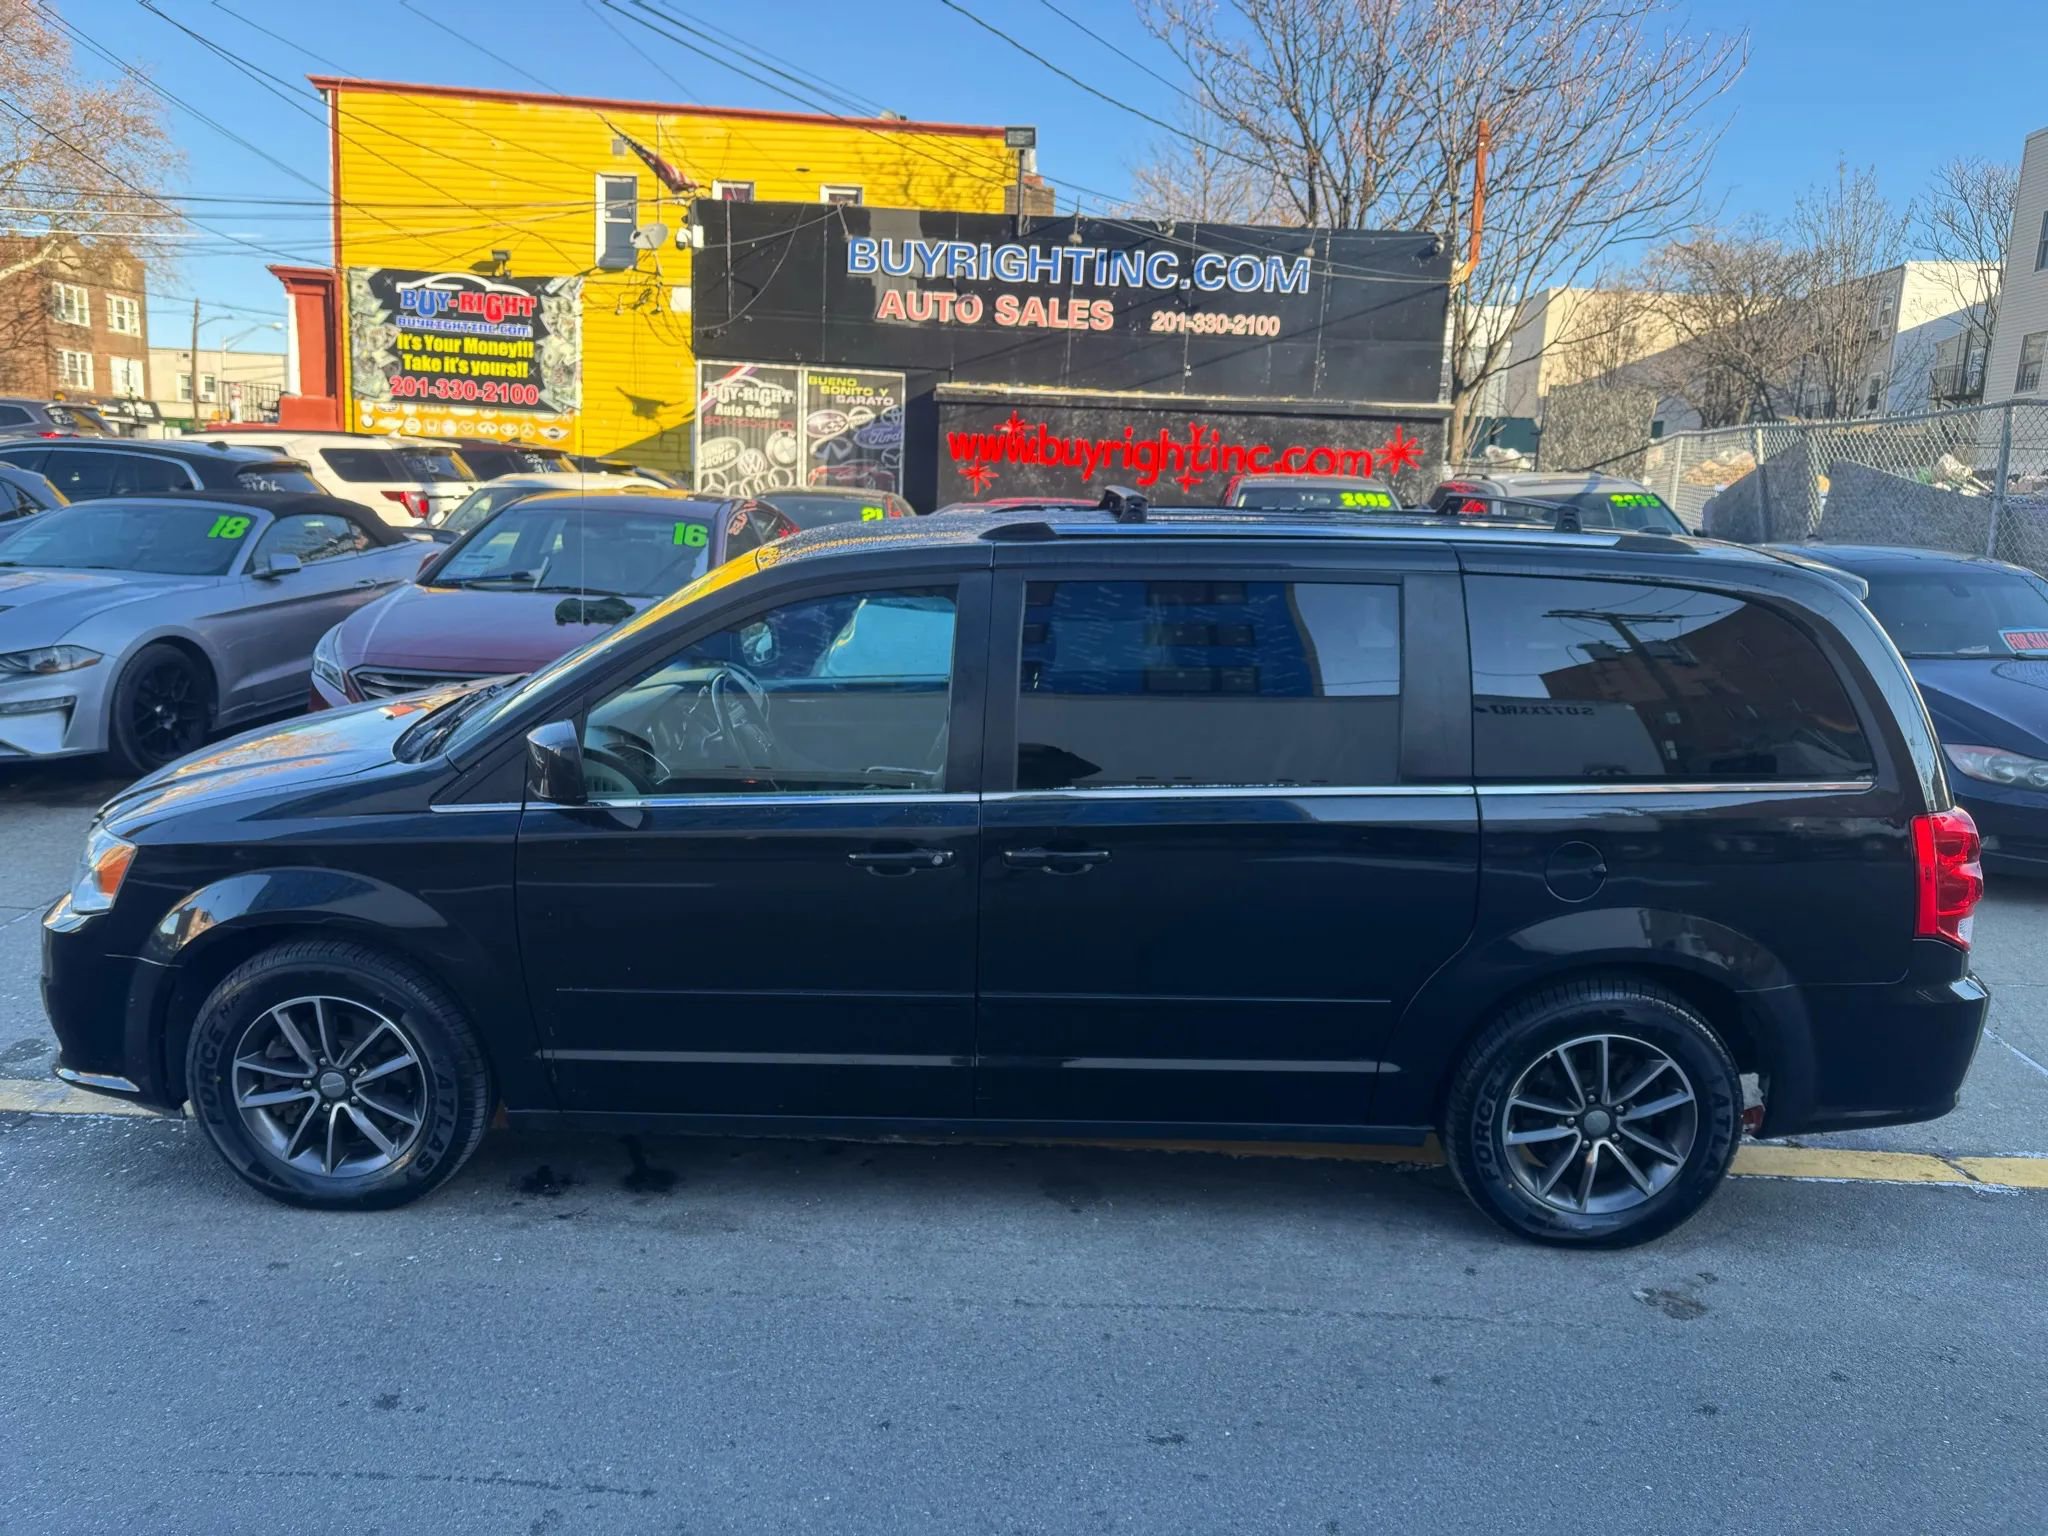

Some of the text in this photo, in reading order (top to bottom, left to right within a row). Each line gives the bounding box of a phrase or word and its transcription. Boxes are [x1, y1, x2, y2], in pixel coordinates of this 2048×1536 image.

[847, 236, 1312, 294] BUYRIGHTINC.COM
[400, 288, 537, 323] BUY-RIGHT
[877, 290, 1114, 331] AUTO SALES
[1150, 310, 1281, 337] 201-330-2100
[423, 334, 461, 353] Your
[463, 337, 535, 359] Money!!!
[402, 353, 529, 378] Take it's yours!!
[389, 375, 539, 405] 201-330-2100
[808, 375, 857, 387] BUENO
[820, 386, 873, 397] BONITO
[714, 402, 779, 419] Auto Sales
[208, 515, 251, 539] 18
[673, 522, 708, 547] 16
[2005, 632, 2033, 650] FOR
[196, 1025, 229, 1126] FORCE
[414, 1069, 457, 1173] ATLAS
[1476, 1073, 1504, 1182] FORCE
